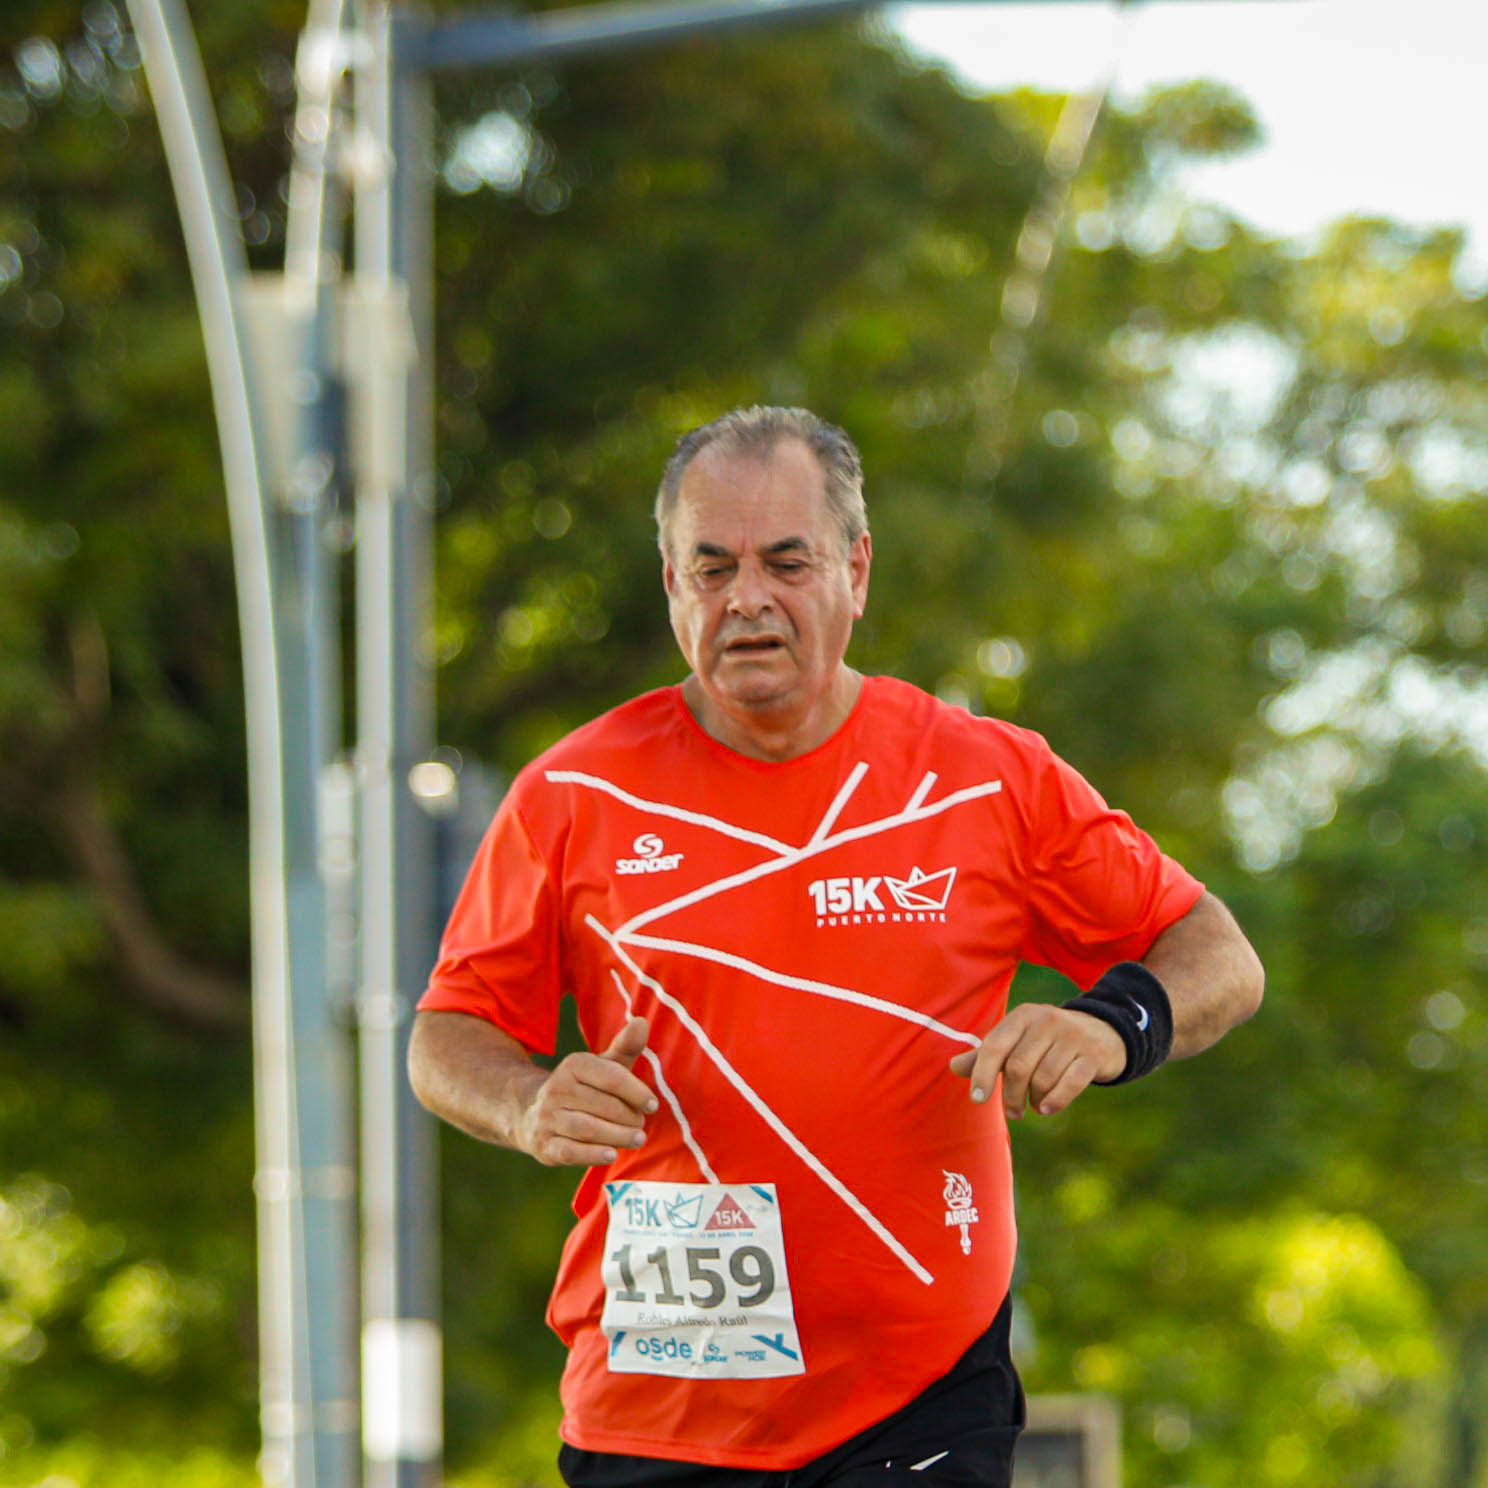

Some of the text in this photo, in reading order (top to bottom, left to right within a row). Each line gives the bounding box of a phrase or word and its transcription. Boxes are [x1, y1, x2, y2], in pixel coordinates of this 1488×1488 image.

[808, 876, 886, 916] 15K
[816, 911, 947, 928] PUERTO NORTE
[624, 1196, 662, 1228] 15K
[714, 1209, 745, 1225] 15K
[611, 1243, 776, 1309] 1159
[635, 1337, 693, 1359] osde
